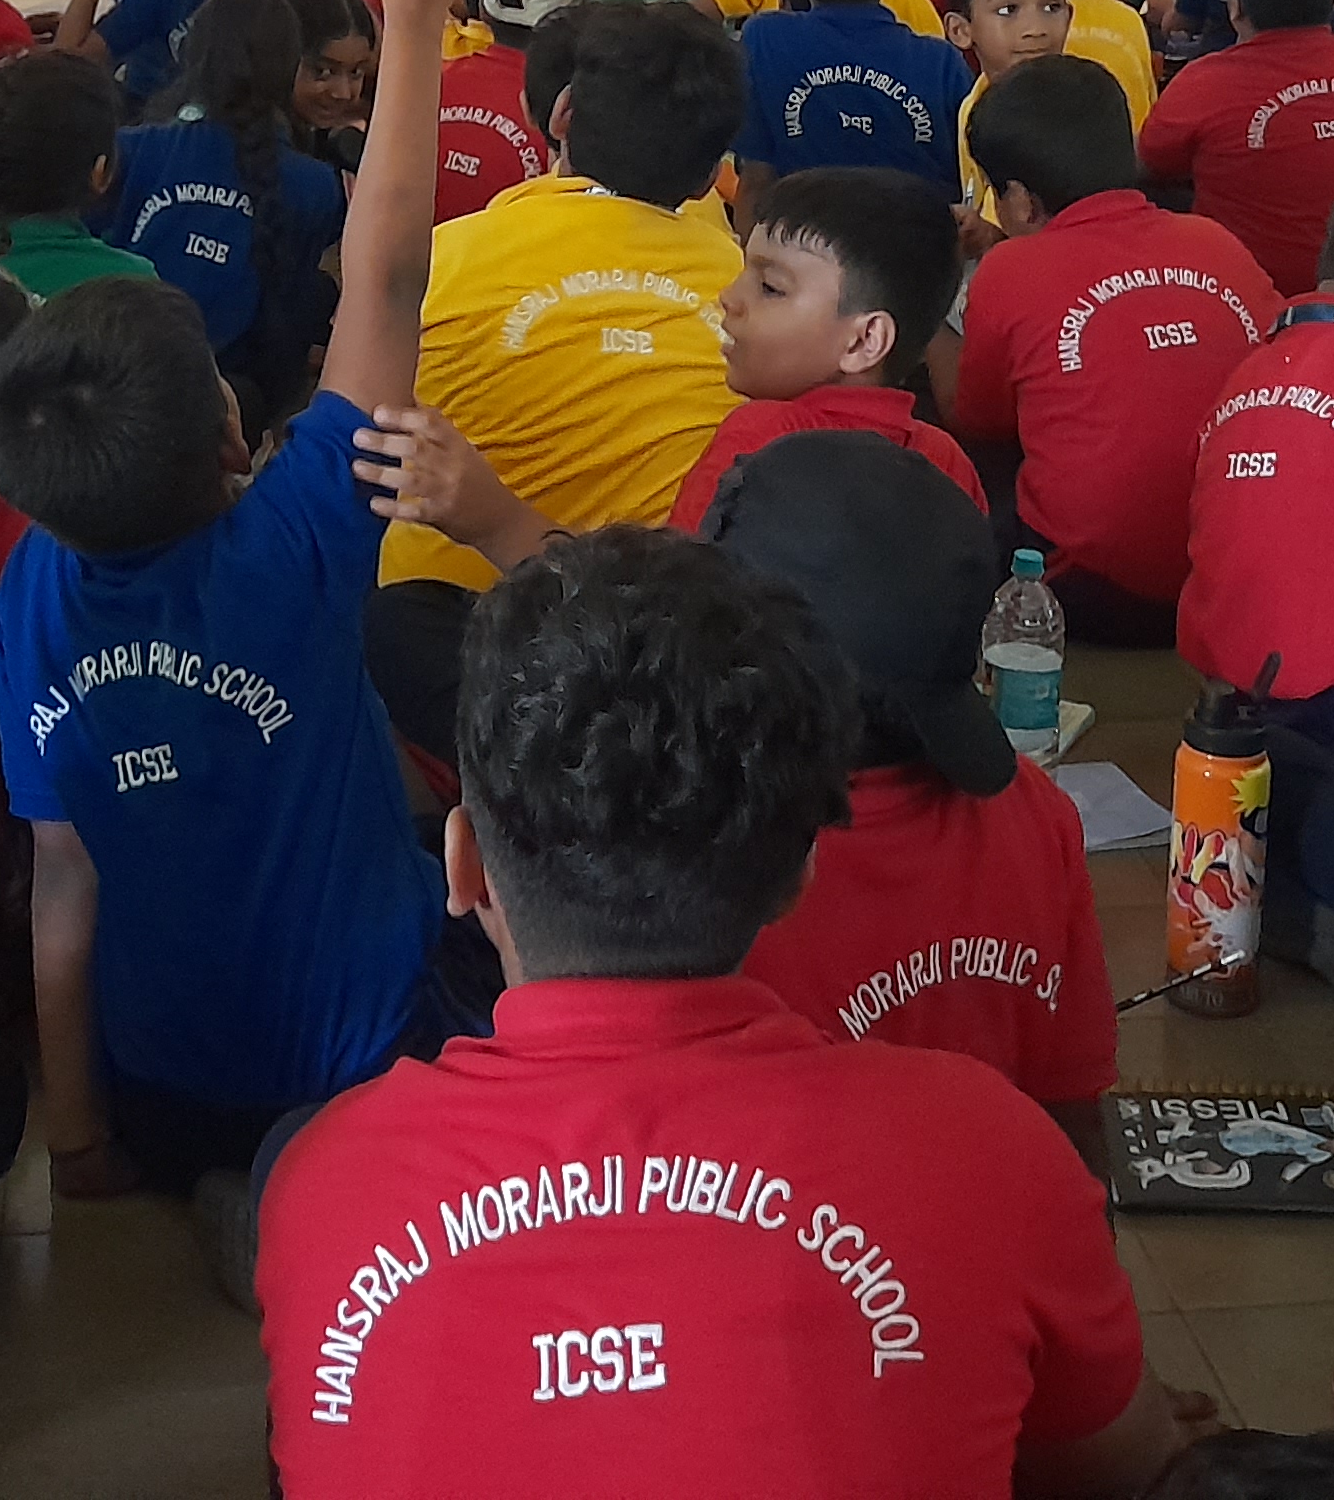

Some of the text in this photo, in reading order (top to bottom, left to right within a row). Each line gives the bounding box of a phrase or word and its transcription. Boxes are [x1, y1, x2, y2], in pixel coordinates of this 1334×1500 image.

[805, 64, 862, 87] MORARJI
[862, 68, 908, 101] PUBLIC
[902, 95, 934, 144] SCHOOL
[1275, 77, 1330, 106] MORARJI
[443, 149, 481, 177] ICSE
[185, 232, 230, 264] ICSE
[642, 271, 700, 309] PUBLIC
[1057, 266, 1262, 373] HANSRAJ MORARJI PUBLIC SCHOOL
[1143, 320, 1199, 350] ICSE
[601, 326, 655, 355] ICSE
[1214, 384, 1284, 428] MORARJI
[1224, 451, 1278, 480] ICSE
[148, 640, 203, 688] PUBLIC
[204, 661, 295, 745] SCHOOL
[112, 742, 179, 793] ICSE
[838, 941, 943, 1043] MORARJI
[950, 935, 1038, 987] PUBLIC
[1150, 1098, 1290, 1121] MESSI
[311, 1154, 926, 1424] HANSRAJ MORARJI PUBLIC SCHOOL
[530, 1322, 667, 1404] ICSE
